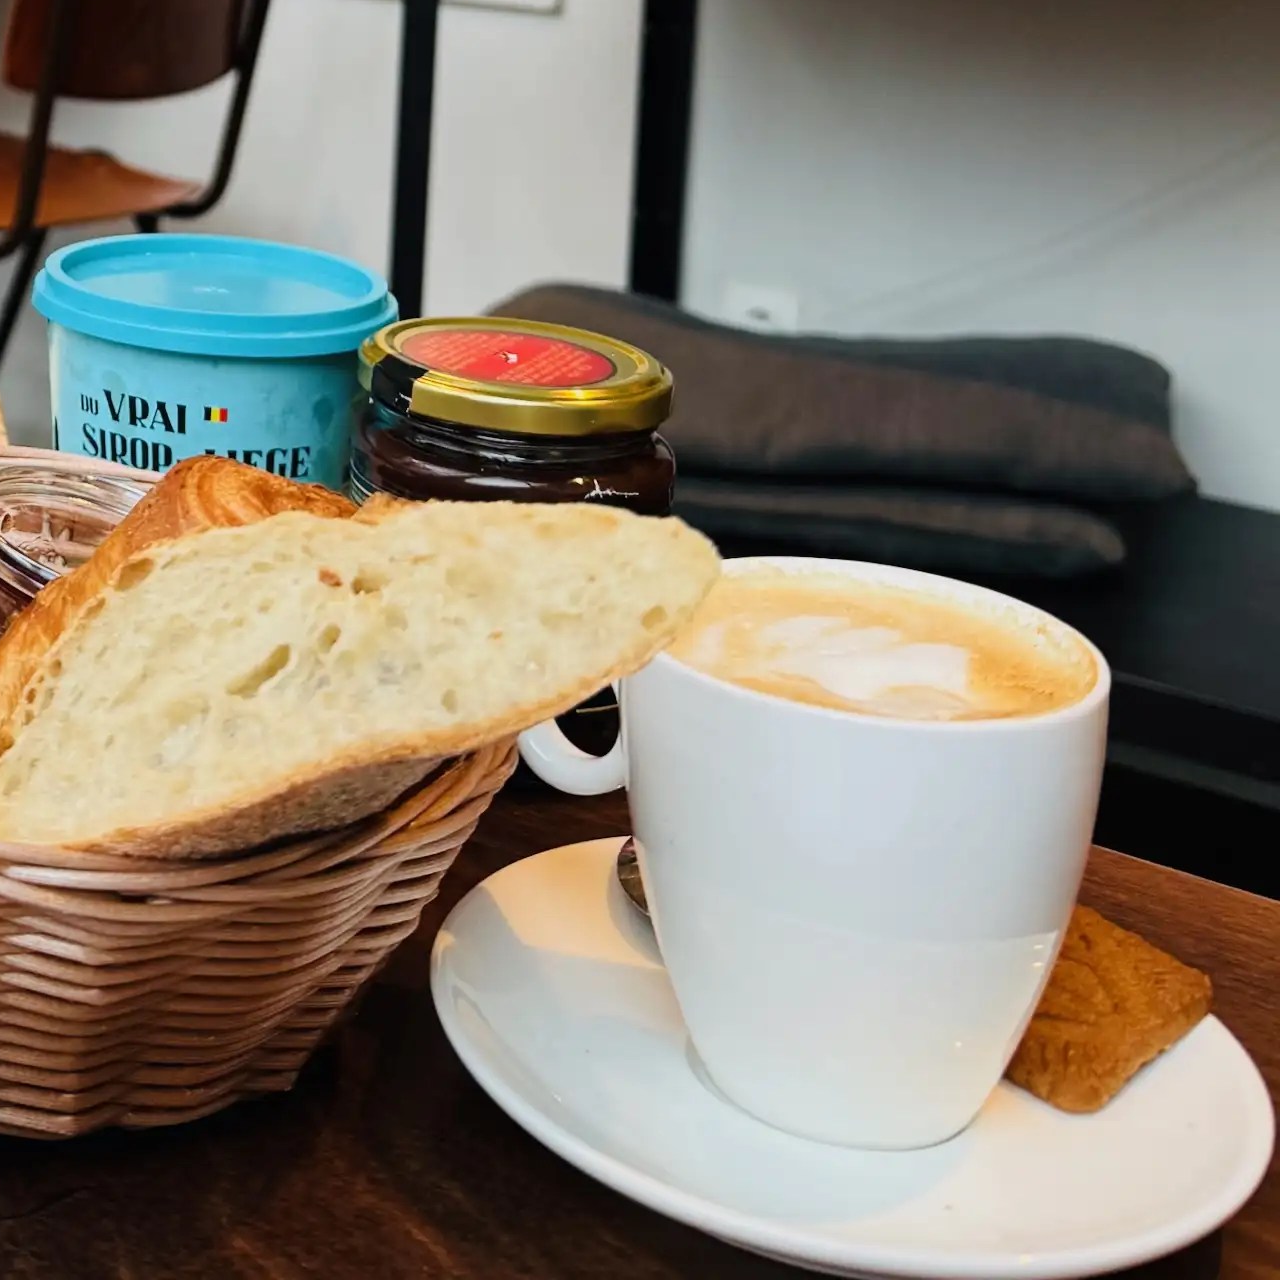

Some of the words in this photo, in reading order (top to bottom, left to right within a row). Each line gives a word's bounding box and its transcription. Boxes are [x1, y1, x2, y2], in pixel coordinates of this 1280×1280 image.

[81, 393, 98, 415] DU
[103, 390, 186, 433] VRAI
[83, 423, 172, 472] SIROP
[205, 447, 310, 478] EGE
